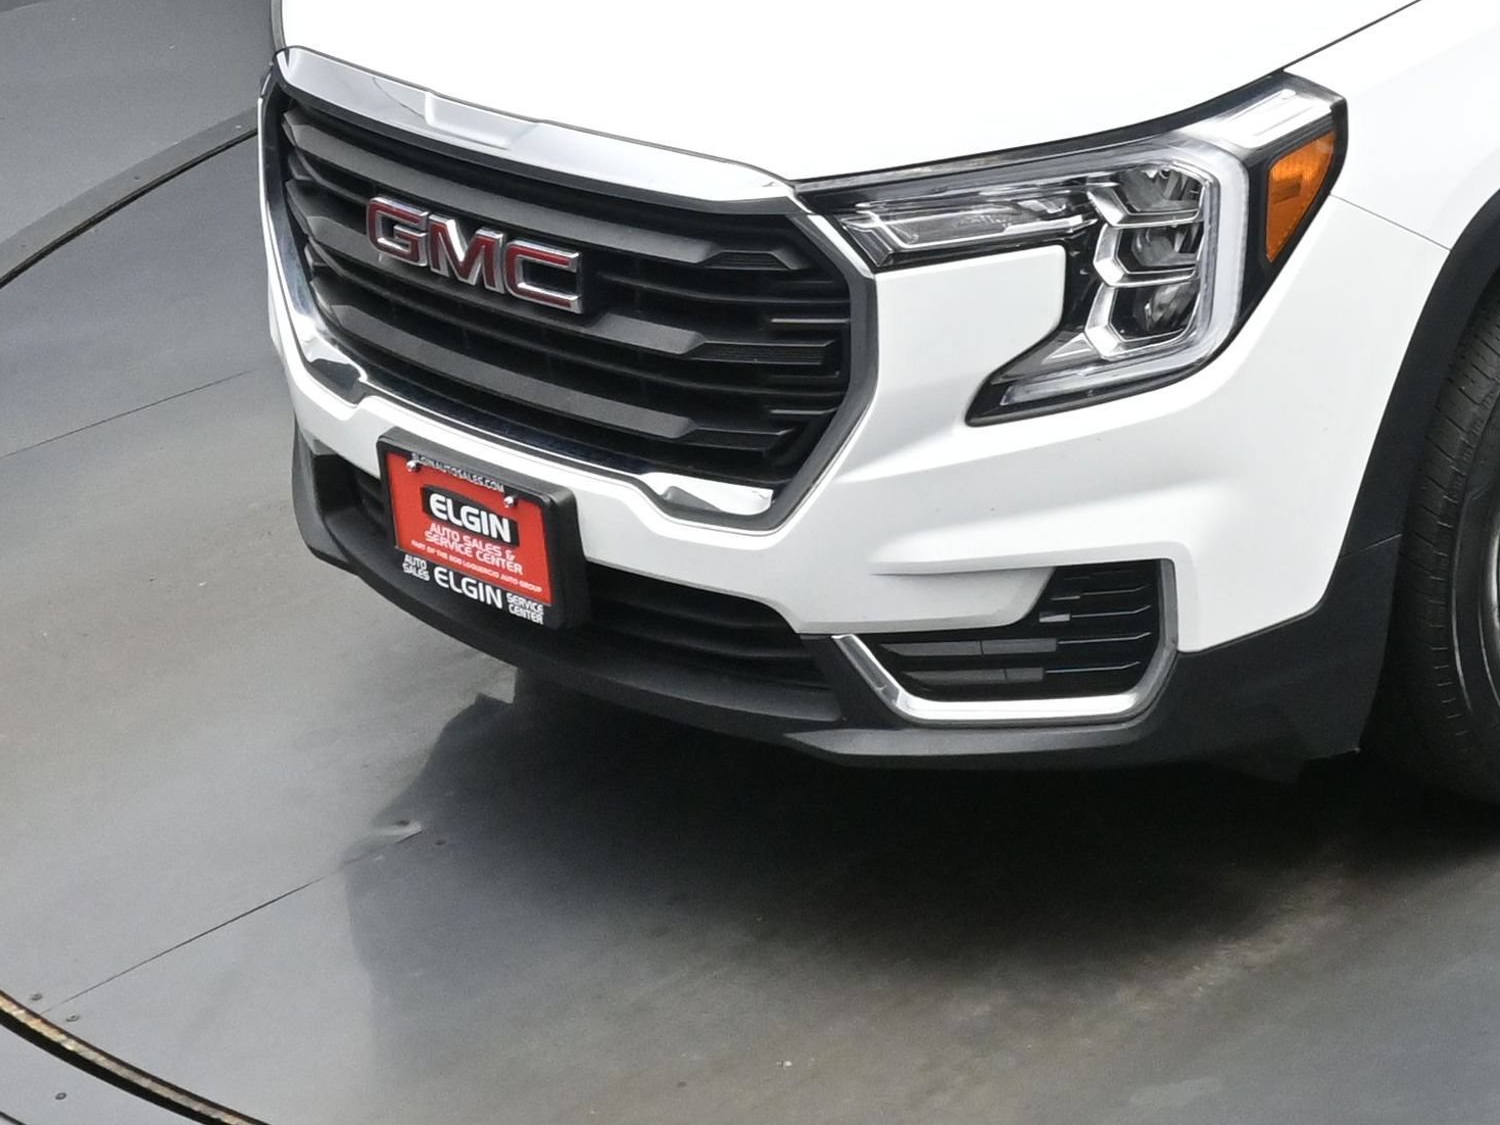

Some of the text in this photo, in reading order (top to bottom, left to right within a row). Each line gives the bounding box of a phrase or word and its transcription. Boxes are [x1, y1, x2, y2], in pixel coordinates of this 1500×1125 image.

[366, 196, 583, 315] GMC
[429, 493, 511, 543] ELGIN
[425, 530, 473, 558] SERVICE
[475, 550, 523, 575] CENTER
[429, 523, 516, 561] AUTO SALES &
[402, 562, 430, 582] SALES
[404, 554, 427, 569] AUTO
[433, 566, 503, 610] ELGIN
[506, 592, 544, 616] SERVICE
[508, 604, 544, 625] CENTER
